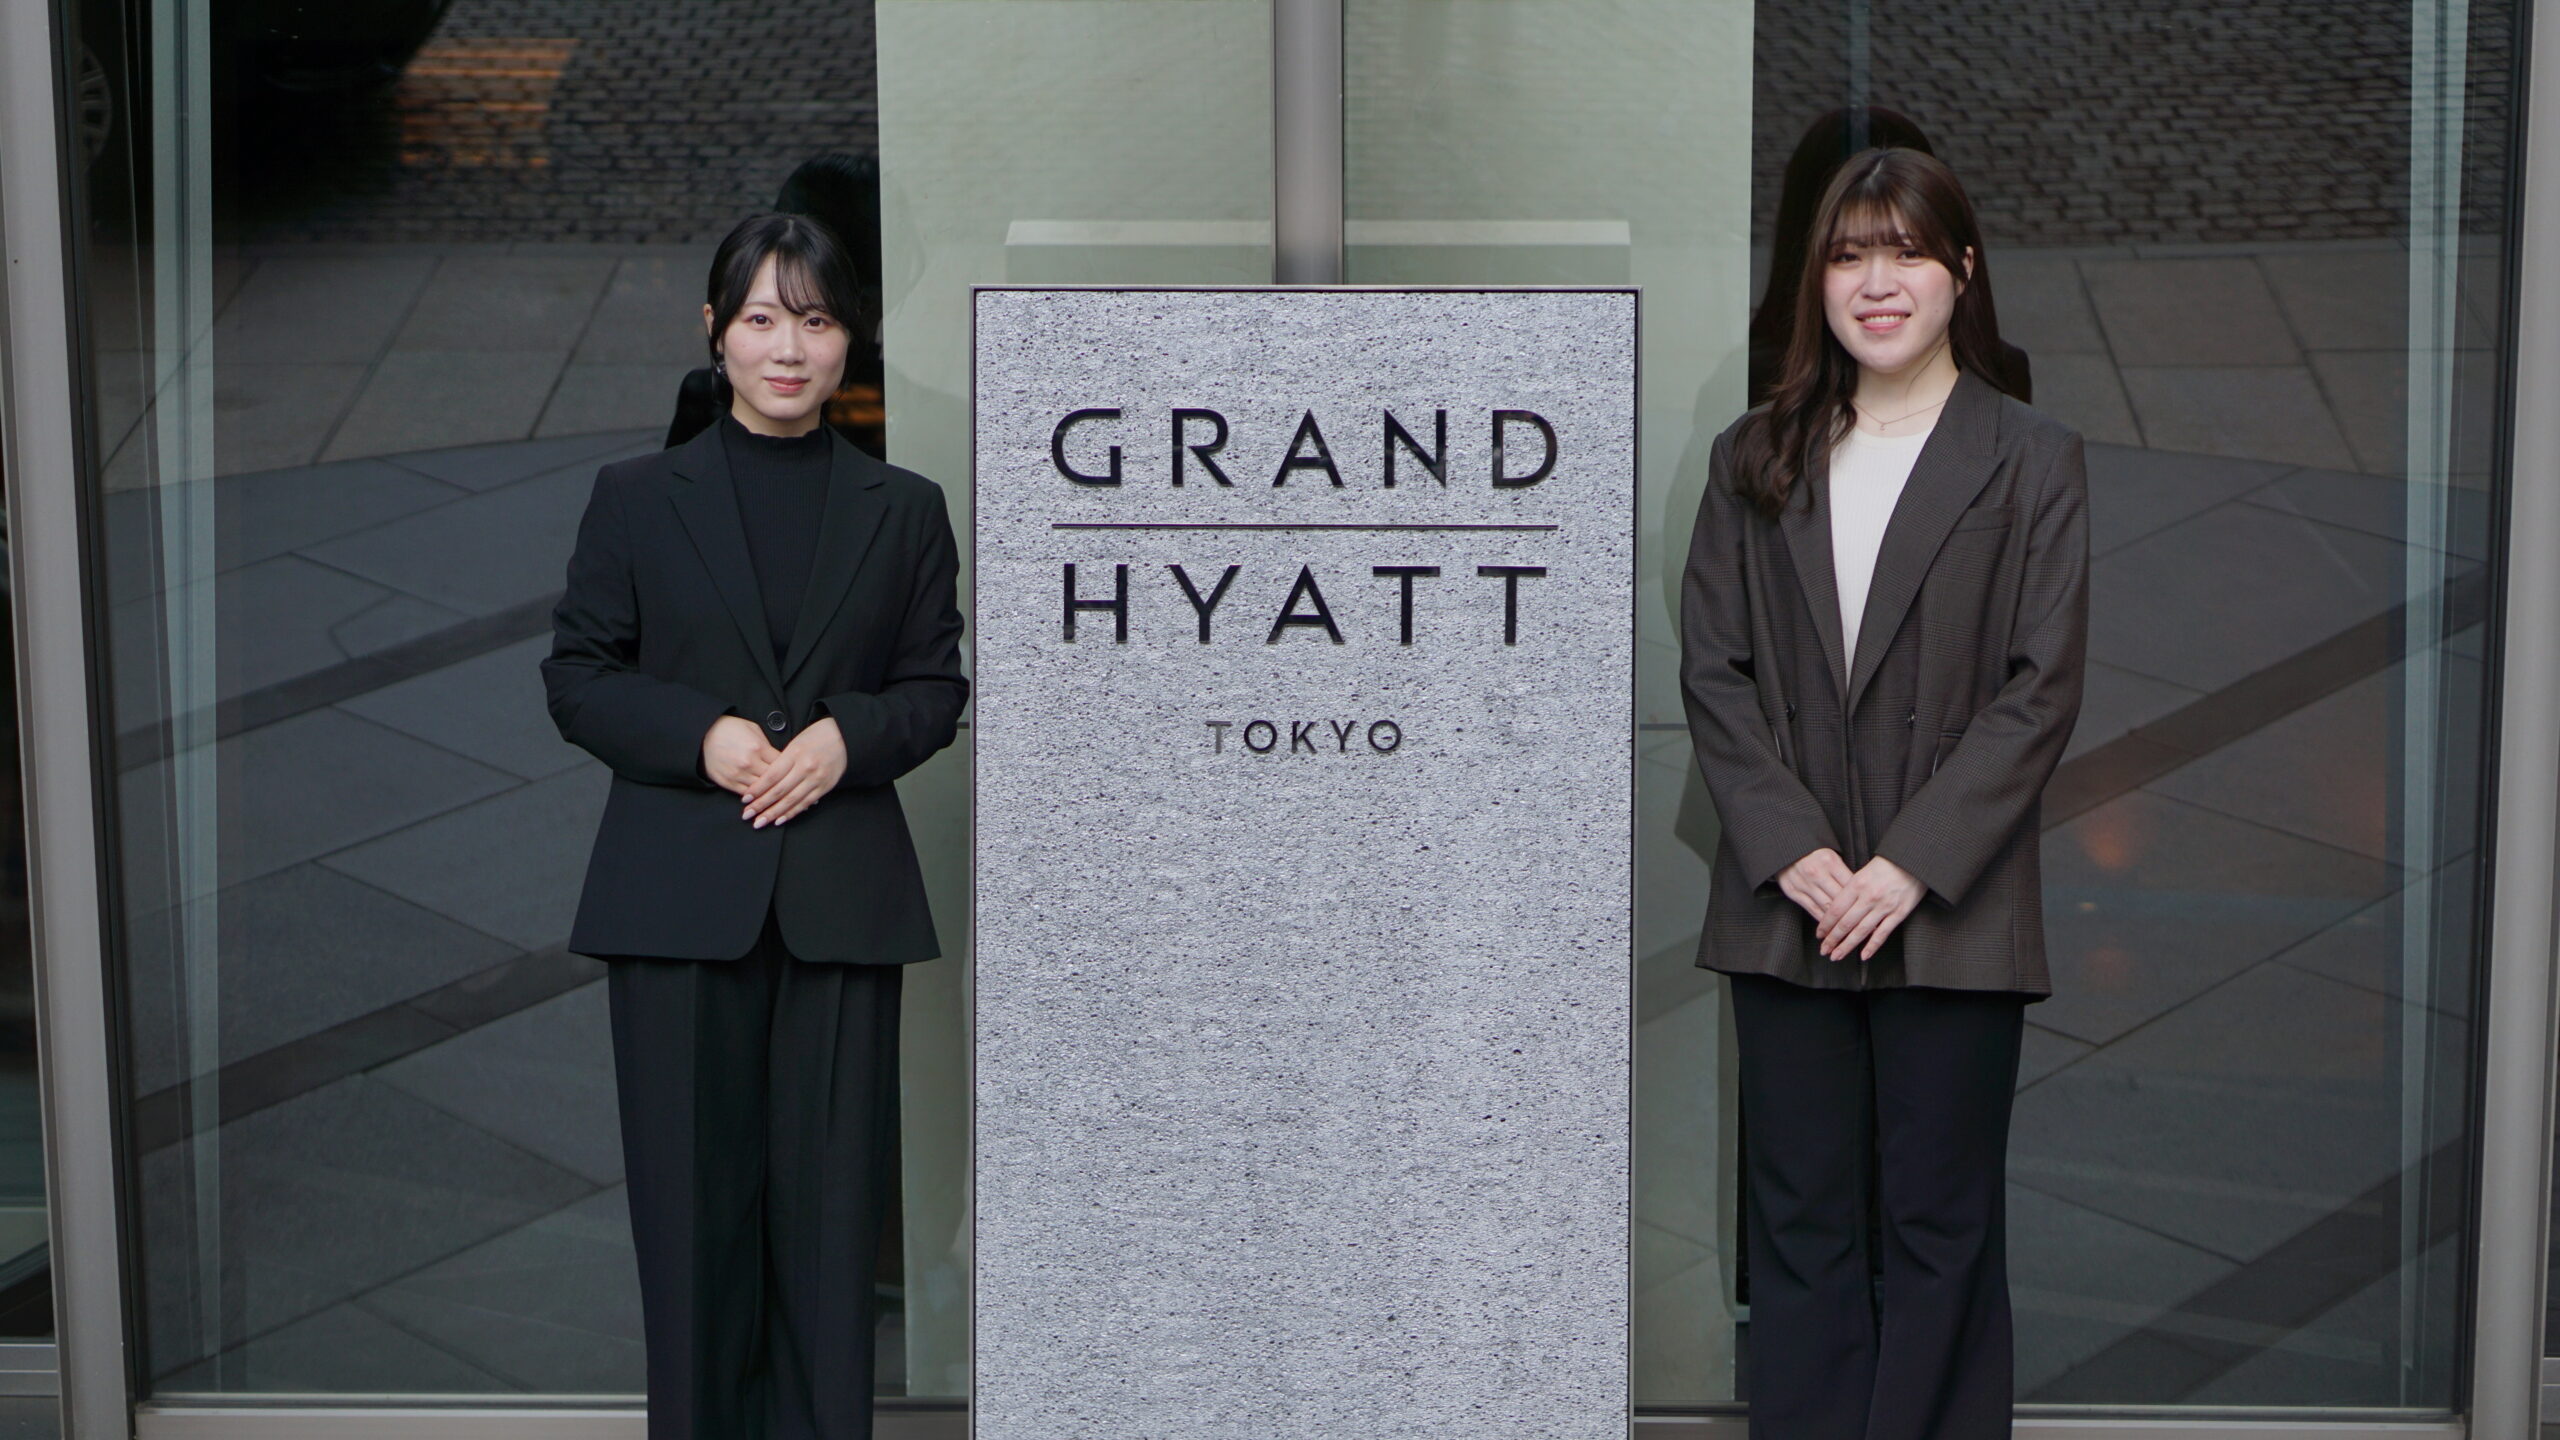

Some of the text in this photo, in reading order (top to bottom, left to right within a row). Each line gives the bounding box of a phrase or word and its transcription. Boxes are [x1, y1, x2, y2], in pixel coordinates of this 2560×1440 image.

[1050, 407, 1559, 490] GRAND
[1062, 563, 1548, 647] HYATT
[1205, 719, 1402, 755] TOKYO
